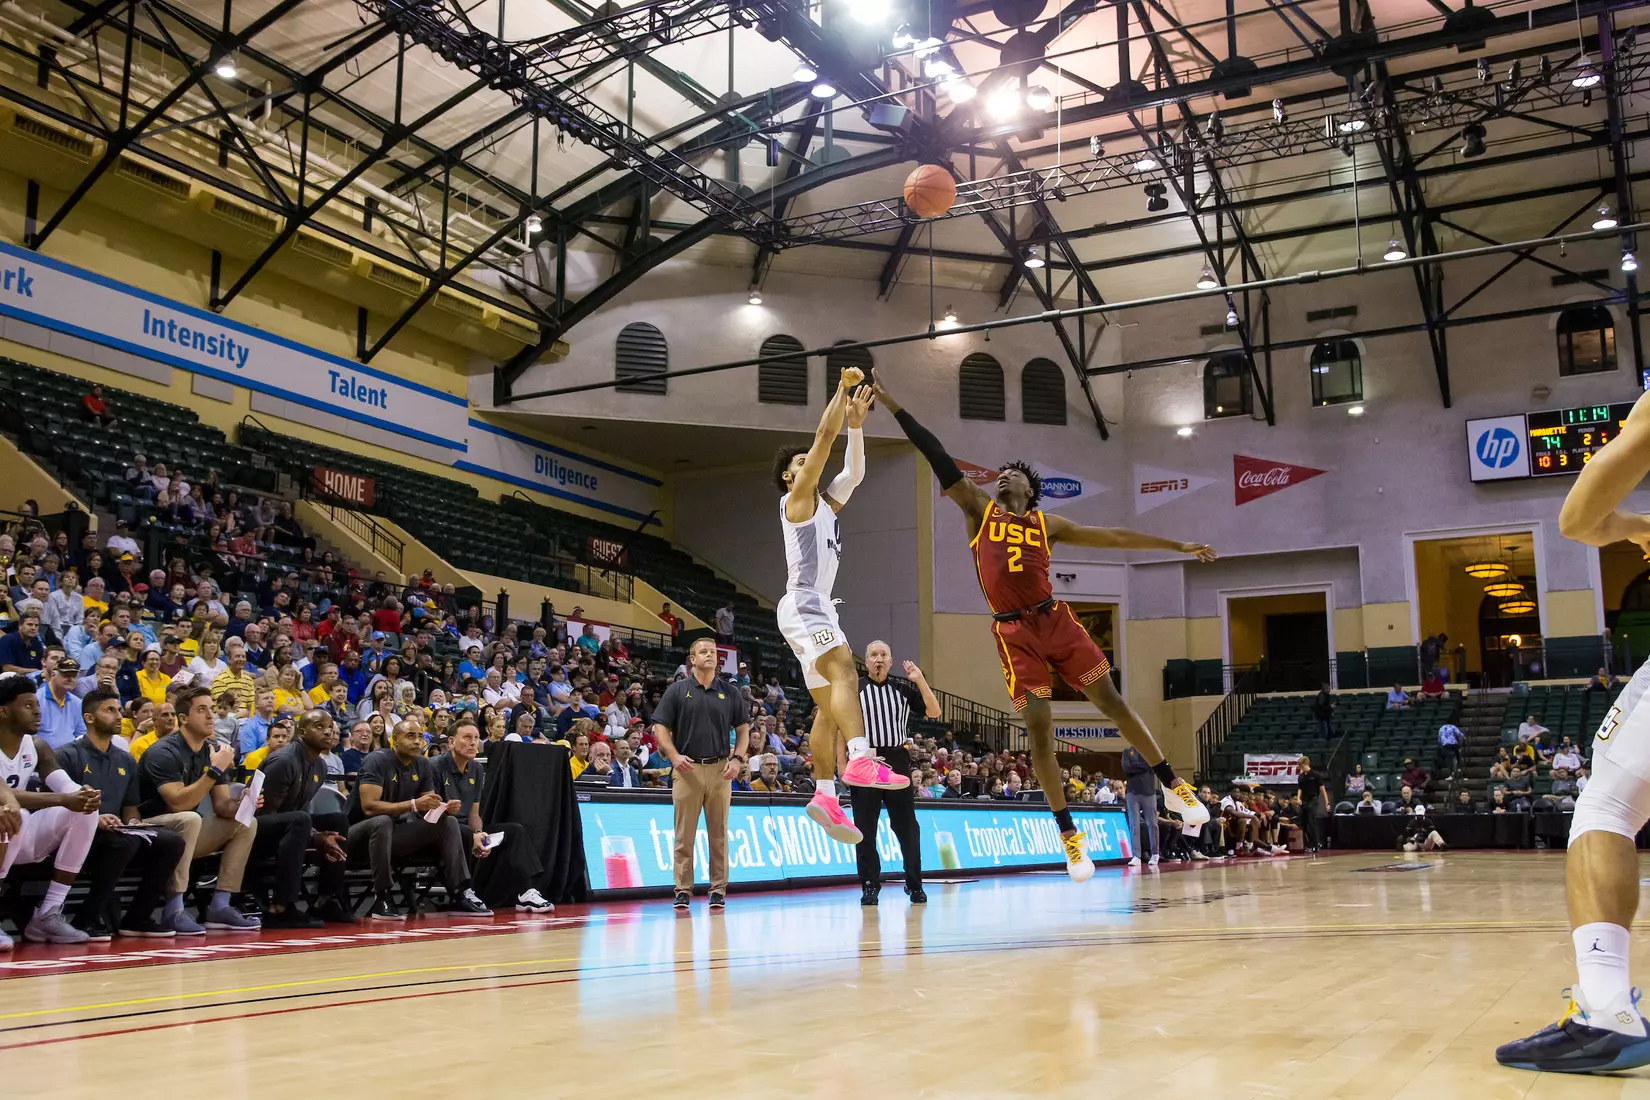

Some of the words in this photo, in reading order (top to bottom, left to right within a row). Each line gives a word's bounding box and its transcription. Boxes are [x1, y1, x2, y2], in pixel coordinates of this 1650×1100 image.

[0, 266, 34, 298] rk
[143, 308, 250, 370] Intensity
[328, 369, 388, 410] Talent
[1569, 406, 1608, 424] 11:14
[1482, 428, 1516, 467] hp
[1541, 436, 1561, 450] 74
[1583, 433, 1592, 446] 2
[534, 453, 598, 491] Diligence
[1538, 456, 1551, 468] 10
[1559, 454, 1568, 466] 3
[324, 470, 366, 502] HOME
[1040, 480, 1080, 492] DANNON
[989, 521, 1041, 548] USC
[592, 538, 624, 564] GUEST
[1007, 546, 1023, 572] 2
[1053, 727, 1105, 739] CESSION
[1246, 761, 1300, 776] ESPN
[649, 815, 765, 881] trpcal
[763, 815, 857, 867] SMOO
[964, 817, 1024, 865] tropical
[1022, 817, 1081, 855] SMOO
[1082, 818, 1111, 852] CAFE
